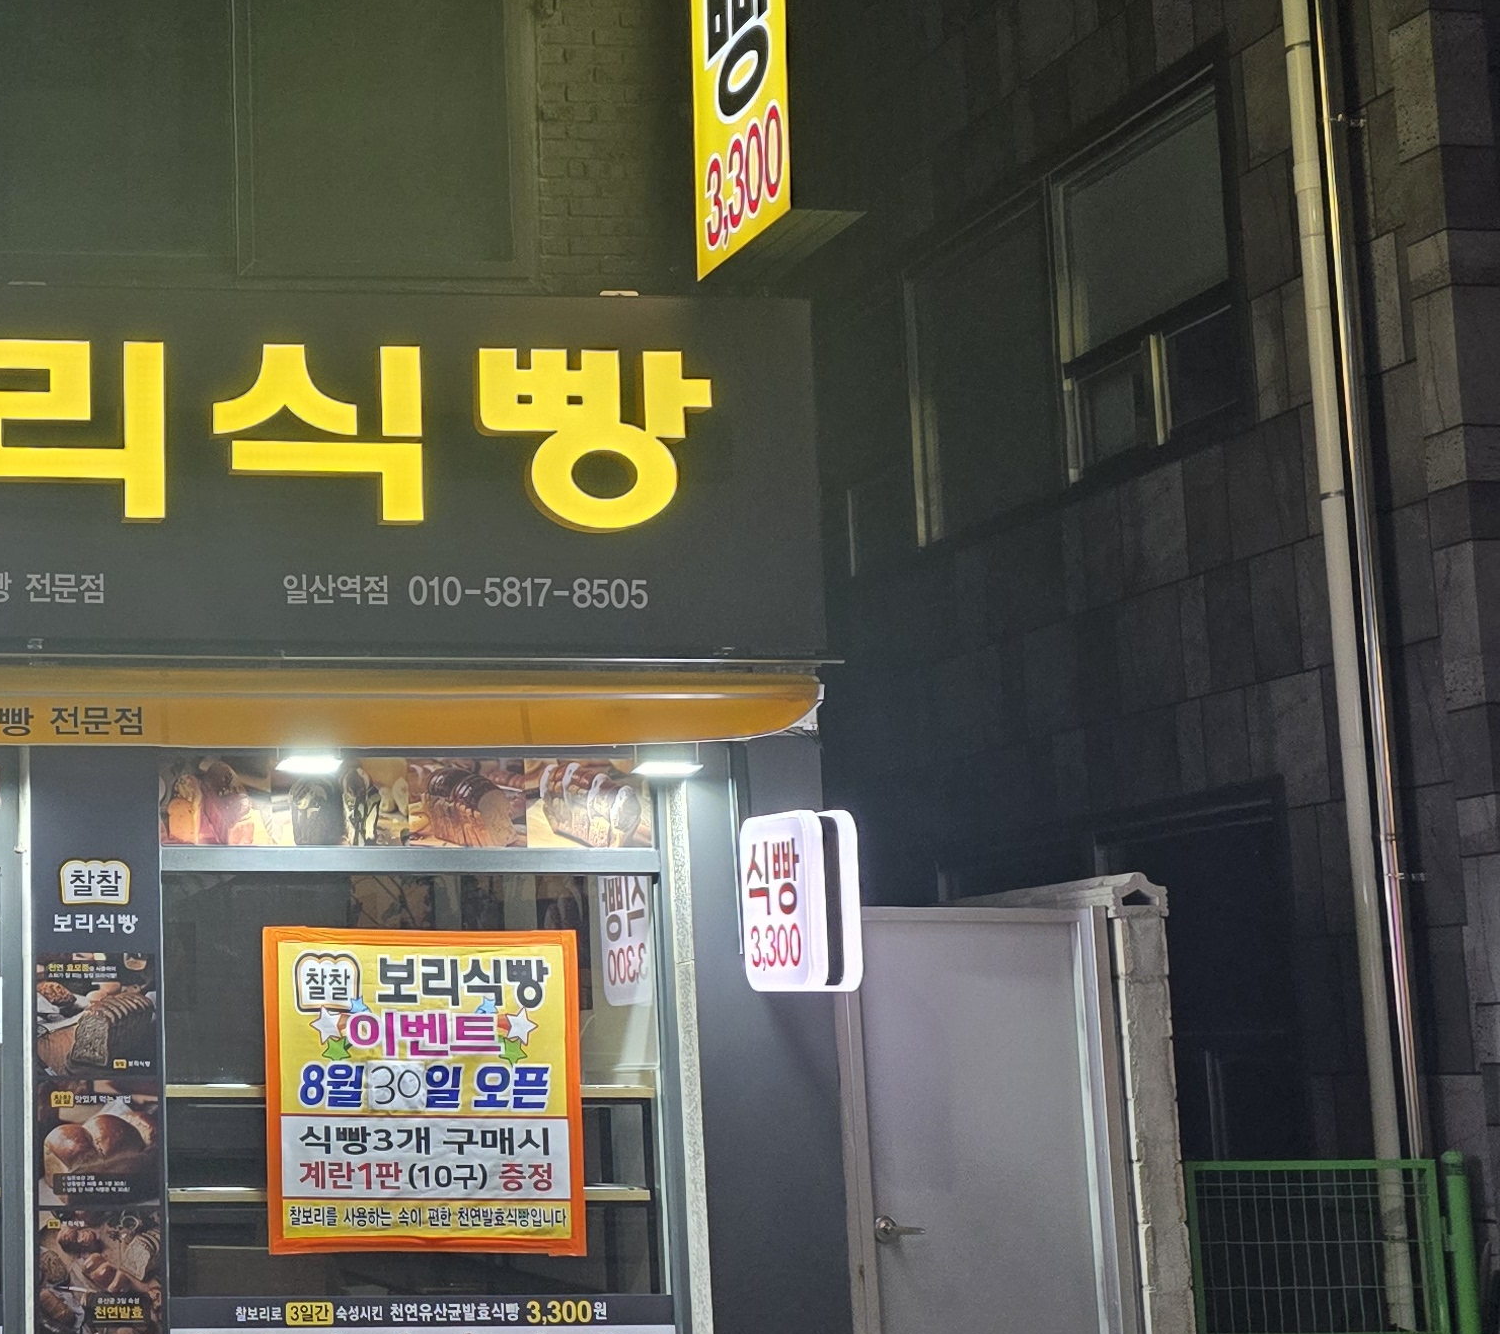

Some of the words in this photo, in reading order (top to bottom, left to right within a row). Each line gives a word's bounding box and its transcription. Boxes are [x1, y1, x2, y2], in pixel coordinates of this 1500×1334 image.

[706, 103, 781, 249] 3,300
[24, 570, 106, 606] 전문점
[282, 571, 390, 609] 일산역점
[408, 576, 649, 612] 010-5817-8505
[49, 703, 146, 738] 전문점
[70, 870, 122, 897] 찰찰
[747, 837, 799, 916] 식빵
[53, 913, 139, 935] 보리식빵
[751, 923, 800, 971] 3,300
[305, 967, 350, 1001] 찰찰
[378, 956, 549, 1009] 보리식빵
[349, 1012, 502, 1057] 이벤트
[472, 1065, 551, 1110] 오픈
[299, 1124, 432, 1156] 식빵3개
[443, 1126, 550, 1157] 구매시
[498, 1162, 553, 1192] 증정
[289, 1206, 338, 1227] 찰보리를
[343, 1207, 393, 1228] 사용하는
[398, 1208, 422, 1228] 속이
[235, 1306, 281, 1322] 찰보리로
[289, 1304, 329, 1322] 3일간
[335, 1306, 383, 1321] 숙성시킨
